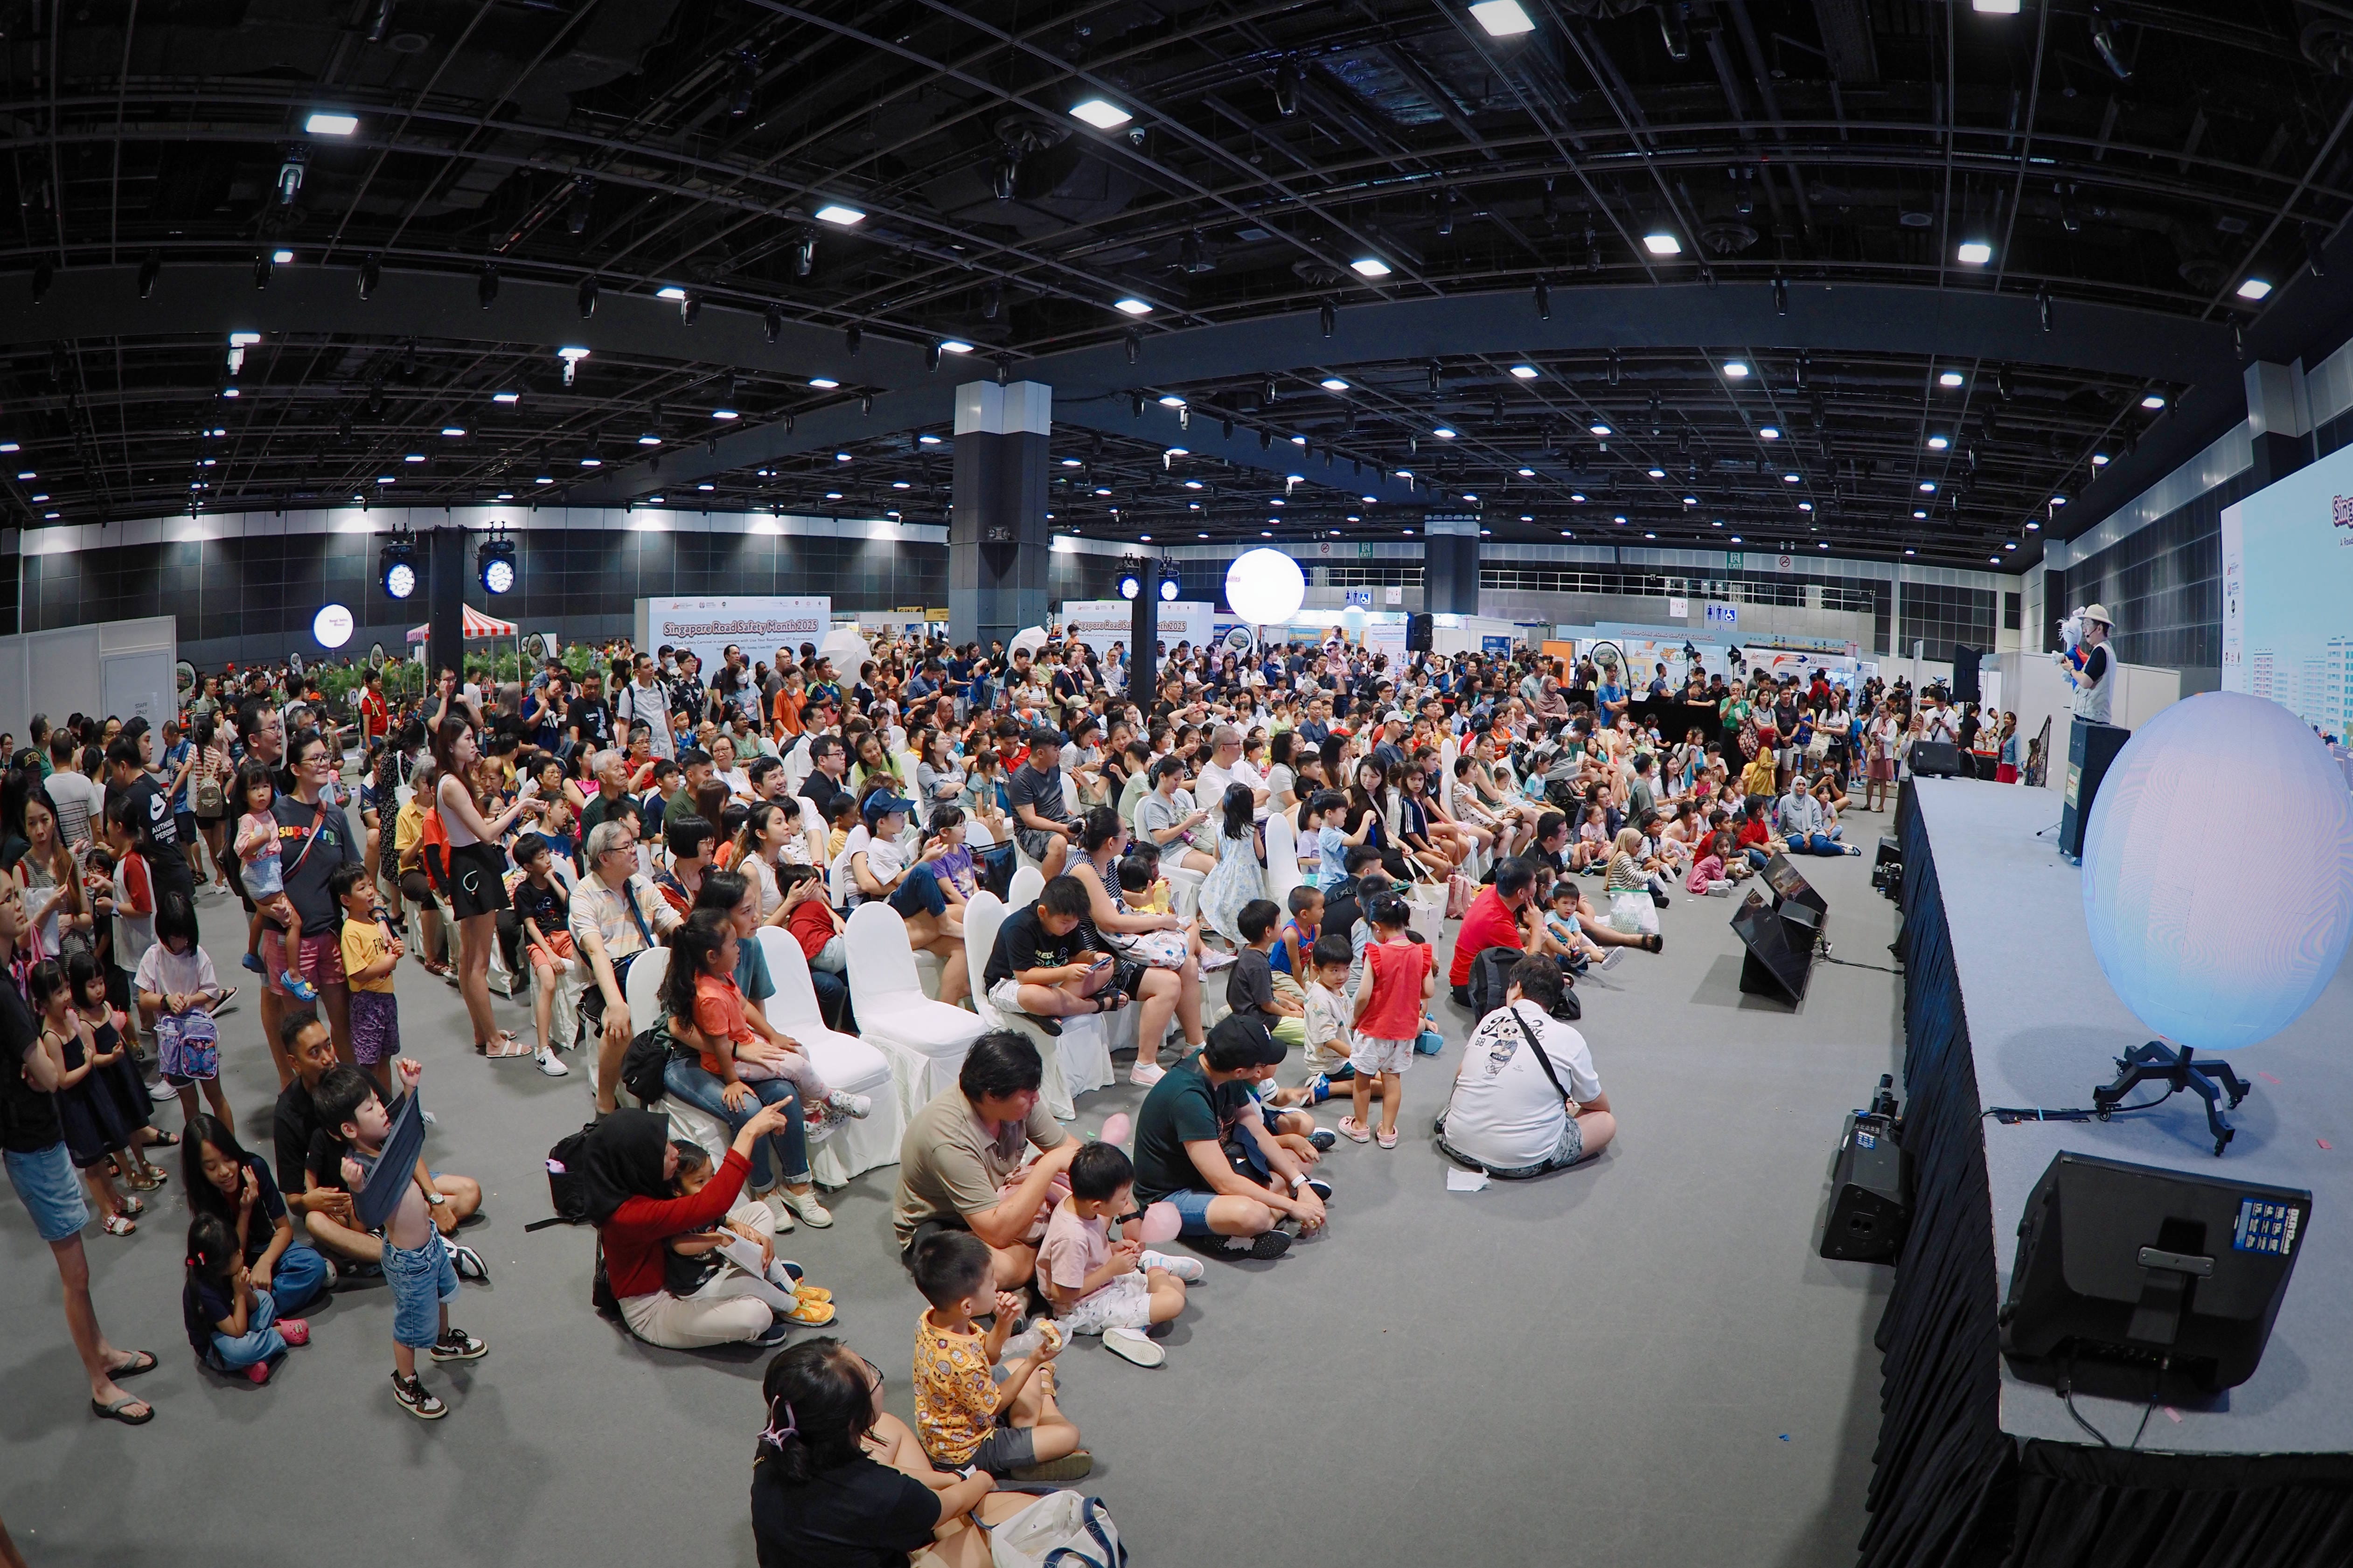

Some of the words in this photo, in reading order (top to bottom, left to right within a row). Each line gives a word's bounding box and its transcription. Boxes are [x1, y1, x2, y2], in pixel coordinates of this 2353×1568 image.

[664, 623, 712, 637] Singapore
[713, 622, 737, 633] Road
[738, 620, 766, 635] Safety
[767, 619, 796, 632] Month
[797, 619, 818, 631] 2025
[1105, 620, 1122, 630] Road
[1169, 620, 1186, 631] 2025
[278, 825, 335, 846] supedry
[373, 936, 385, 955] FIR
[1475, 1037, 1486, 1047] 68
